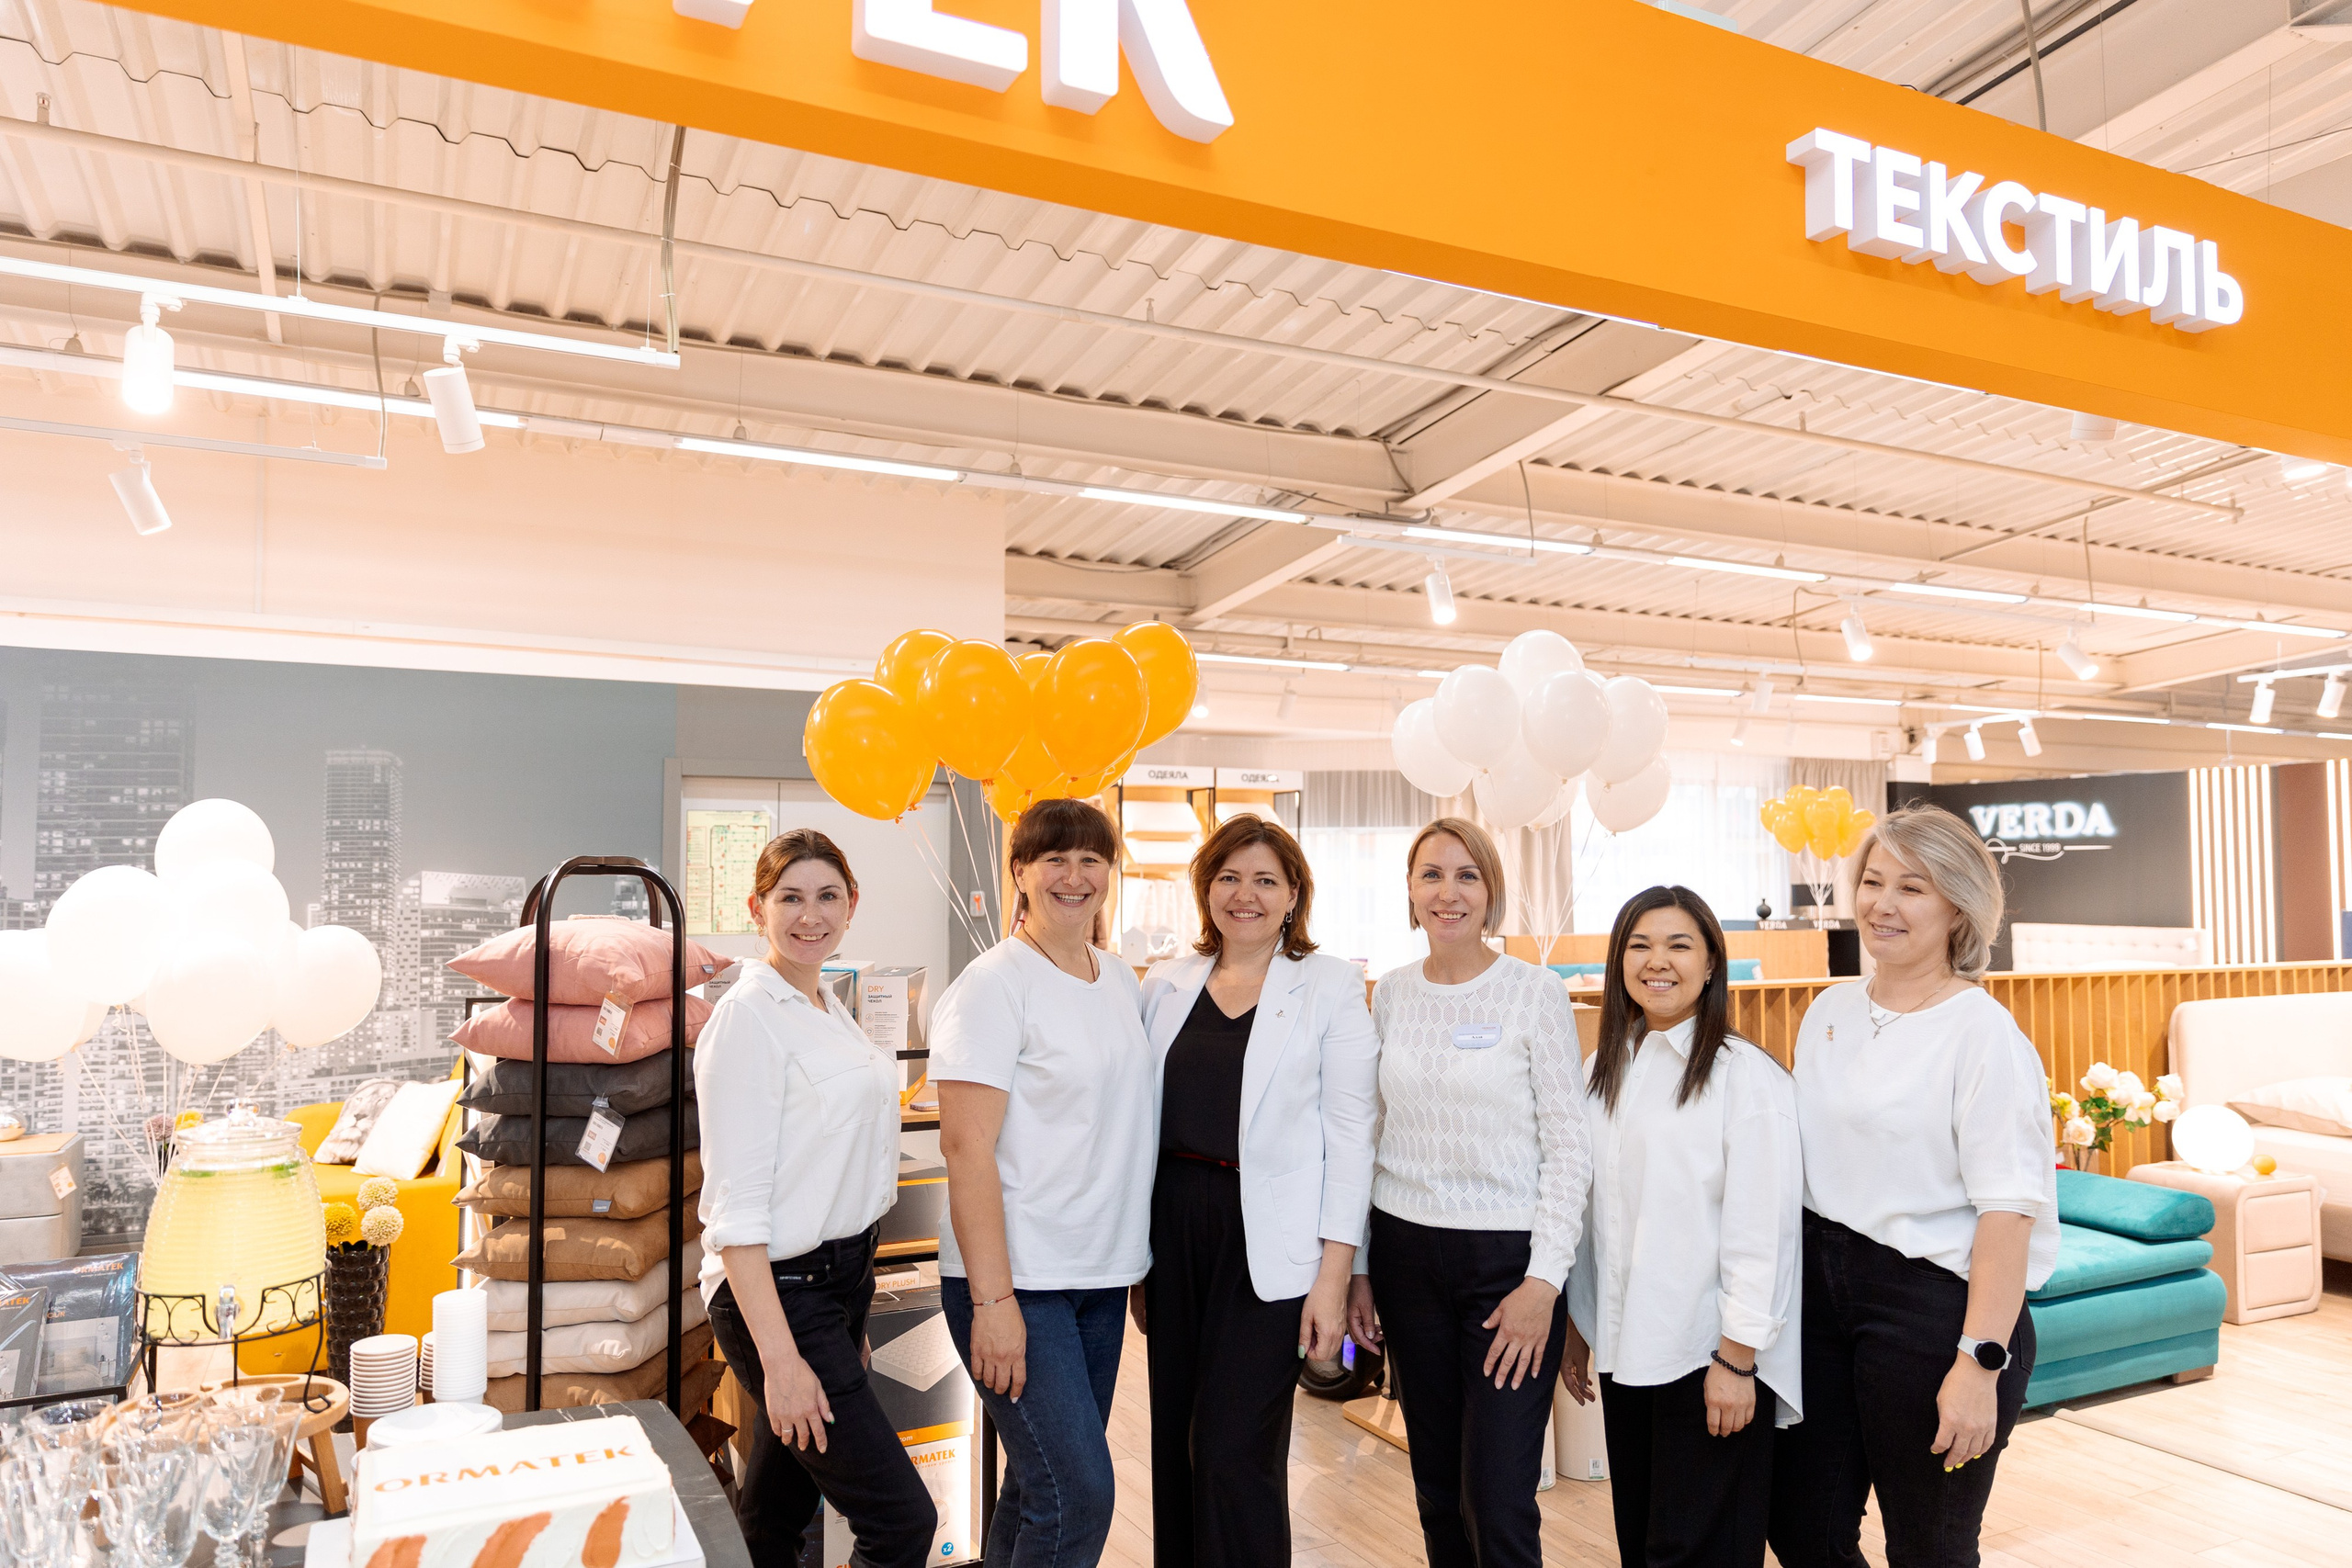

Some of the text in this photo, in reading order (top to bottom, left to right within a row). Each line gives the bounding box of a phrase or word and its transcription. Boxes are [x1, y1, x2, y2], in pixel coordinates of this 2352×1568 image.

[1786, 127, 2244, 333] ТЕКСТИЛЬ
[1148, 769, 1189, 780] ОДЕЯЛА
[1968, 801, 2117, 838] VERDA
[2018, 842, 2041, 853] SINCE
[867, 985, 885, 993] DRY
[876, 1278, 916, 1290] DRY PLUSH
[911, 1449, 956, 1465] RMATEK
[374, 1445, 636, 1493] ORMATEK
